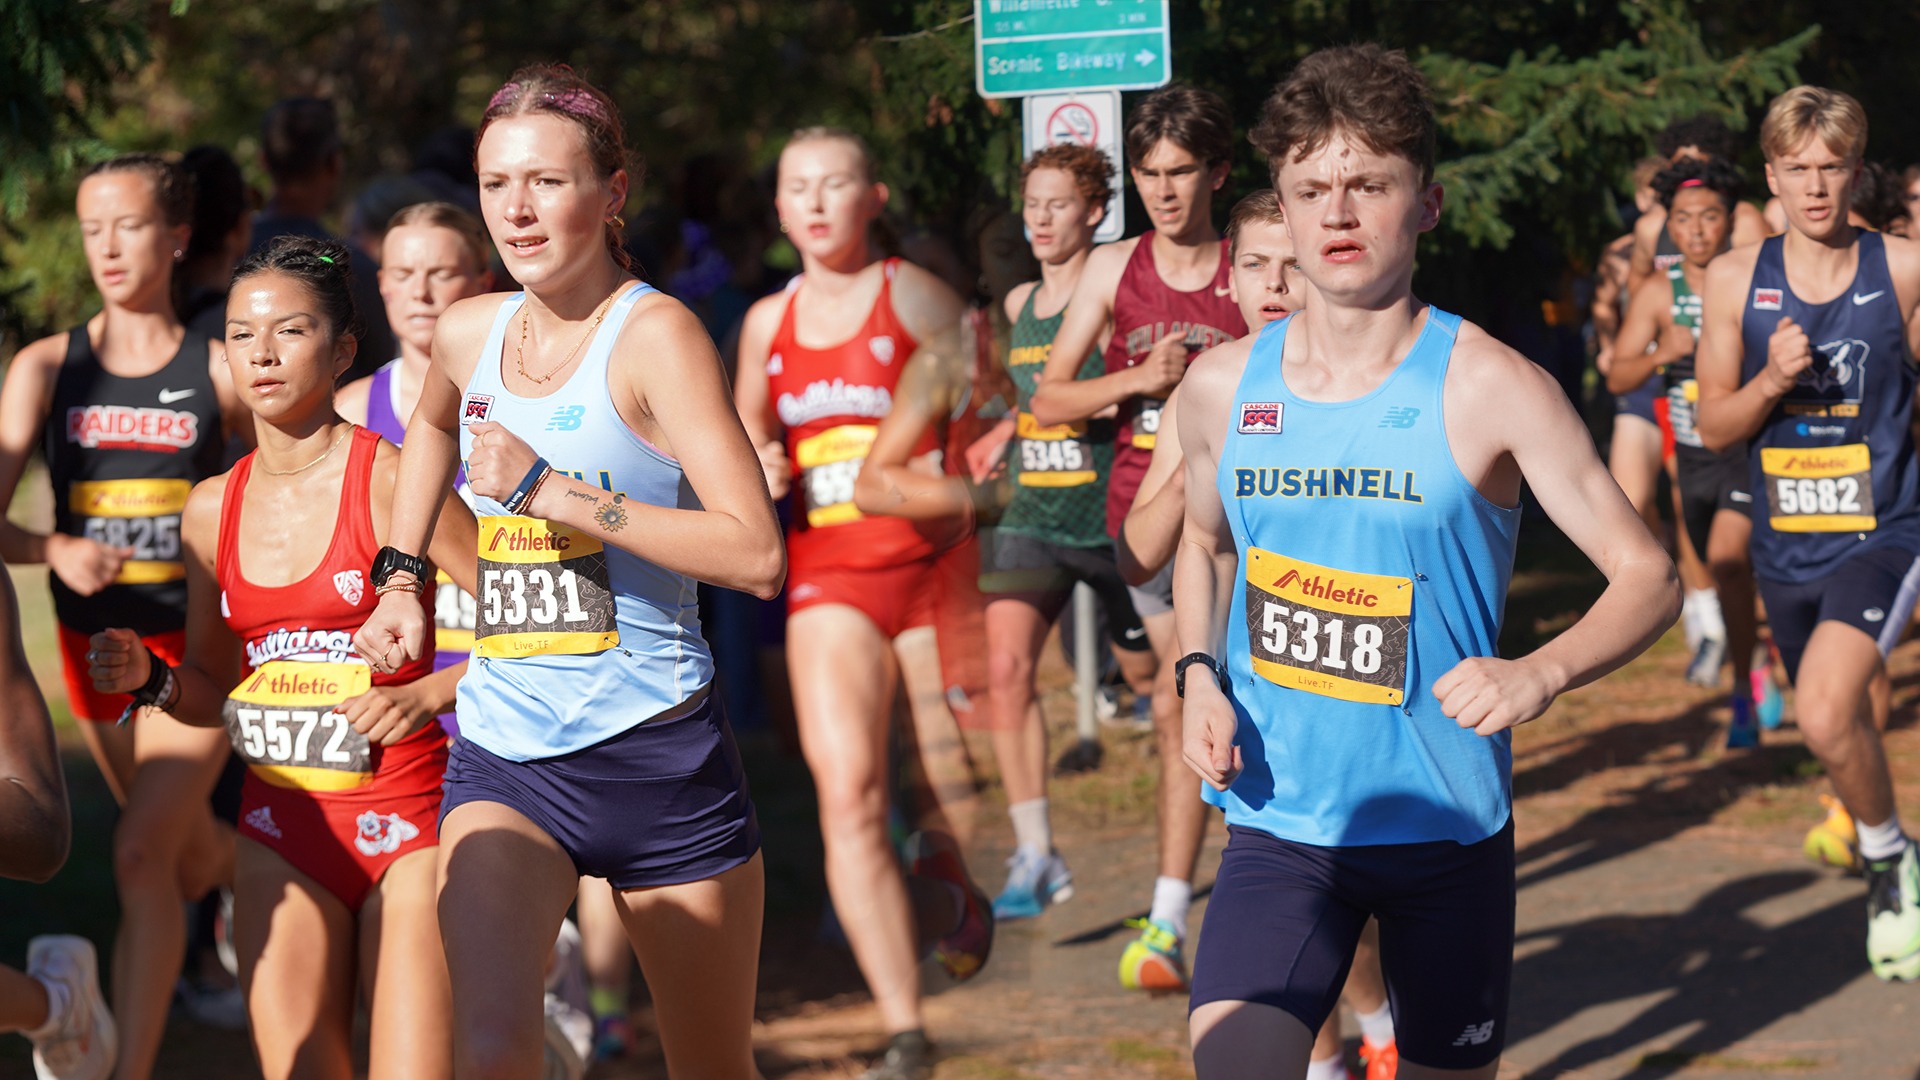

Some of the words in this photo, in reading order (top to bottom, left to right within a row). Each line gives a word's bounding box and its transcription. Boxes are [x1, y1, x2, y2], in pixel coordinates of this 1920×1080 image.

[987, 54, 1044, 76] Scenic
[1056, 51, 1126, 71] Bikeway
[68, 405, 198, 448] RAIDERS
[1245, 411, 1277, 425] CCC
[1021, 438, 1083, 470] 5345
[1234, 468, 1424, 504] BUSHNELL
[1777, 477, 1861, 514] 5682
[488, 526, 571, 552] Athletic
[483, 568, 589, 626] 5331
[1272, 569, 1379, 608] Athletic
[513, 640, 549, 651] Live.TF
[1261, 601, 1383, 675] 5318
[246, 672, 339, 696] Athletic
[1298, 676, 1335, 691] Live.TF
[236, 708, 351, 763] 5572
